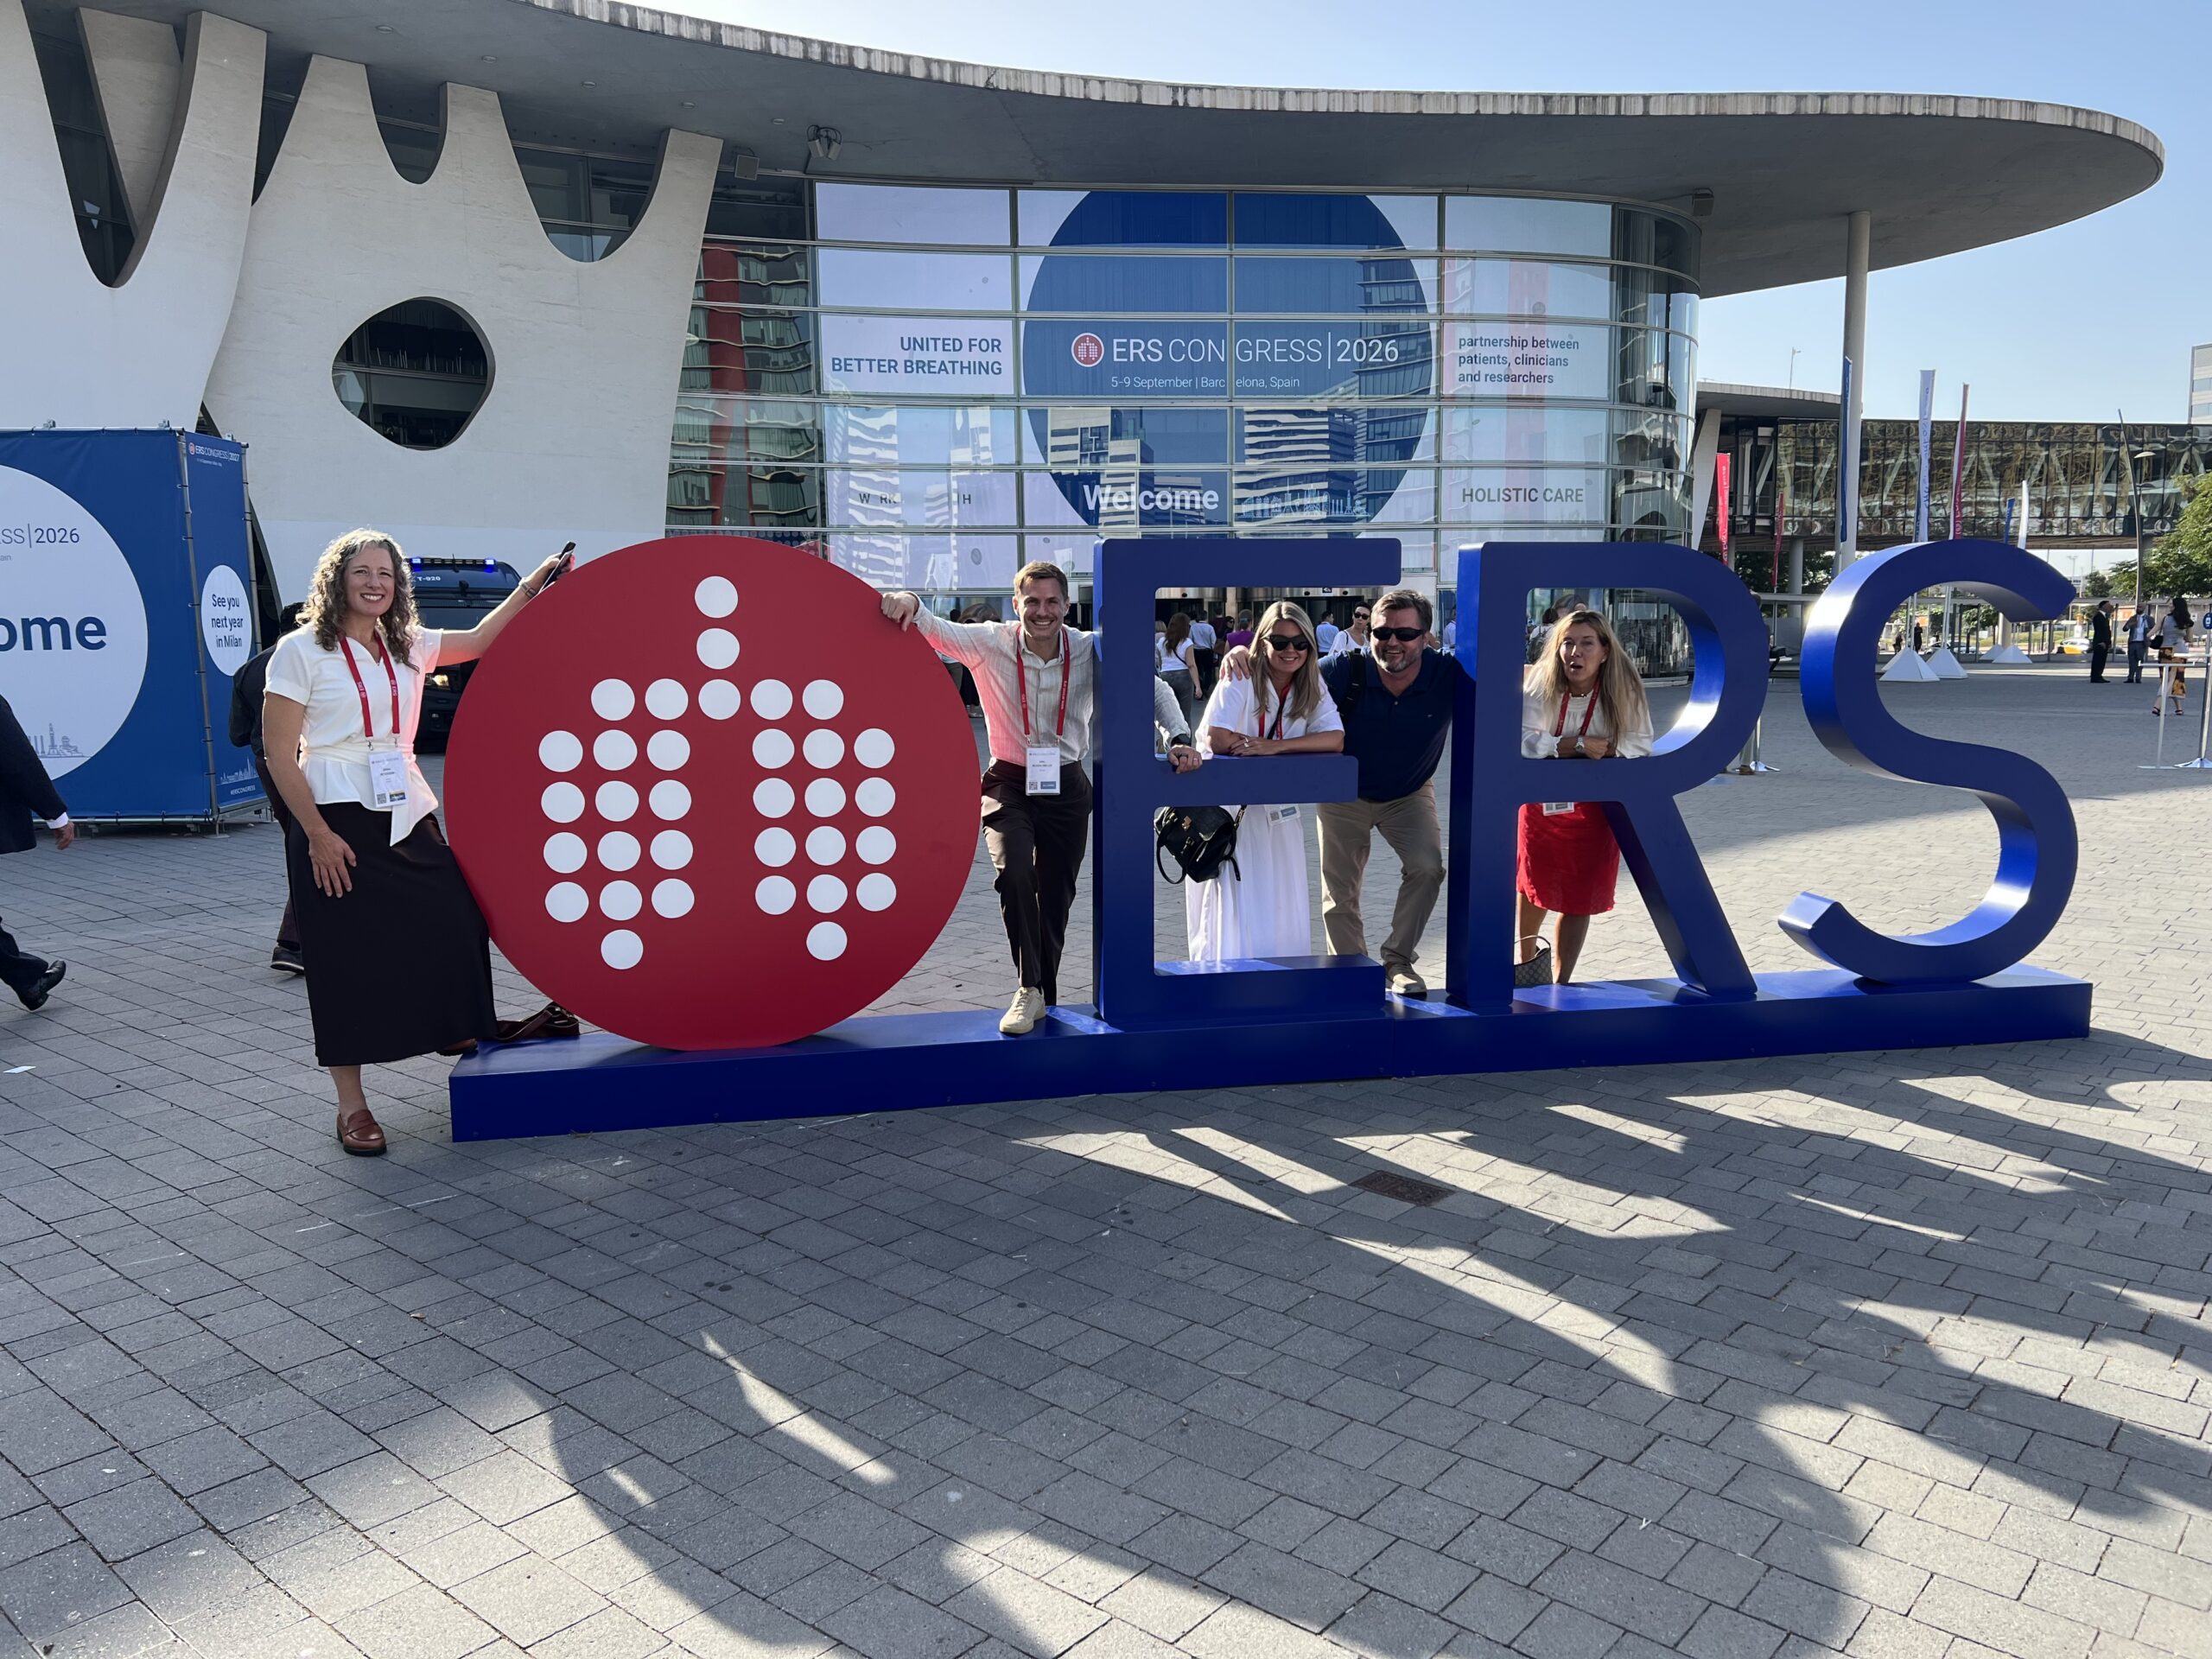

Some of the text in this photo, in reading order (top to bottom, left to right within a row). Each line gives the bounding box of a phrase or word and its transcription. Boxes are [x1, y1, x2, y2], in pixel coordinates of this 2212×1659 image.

[900, 336, 1001, 353] UNITED FOR
[1113, 338, 1399, 363] ERS CONGRESS 2026
[1459, 335, 1580, 351] partnership between
[831, 357, 1002, 376] BETTER BREATHING
[1458, 353, 1569, 367] patients, clinicians
[1111, 376, 1131, 388] 5-9
[1133, 376, 1193, 390] September
[1269, 376, 1300, 389] Spain
[1458, 370, 1554, 384] and researchers
[1083, 483, 1219, 511] Welcome
[1461, 487, 1584, 503] HOLISTIC CARE
[0, 527, 80, 544] SS 2026
[212, 594, 239, 610] See you
[211, 616, 244, 632] next year
[0, 616, 107, 652] ome
[216, 635, 243, 648] in Milan
[1093, 536, 2080, 1023] ERS
